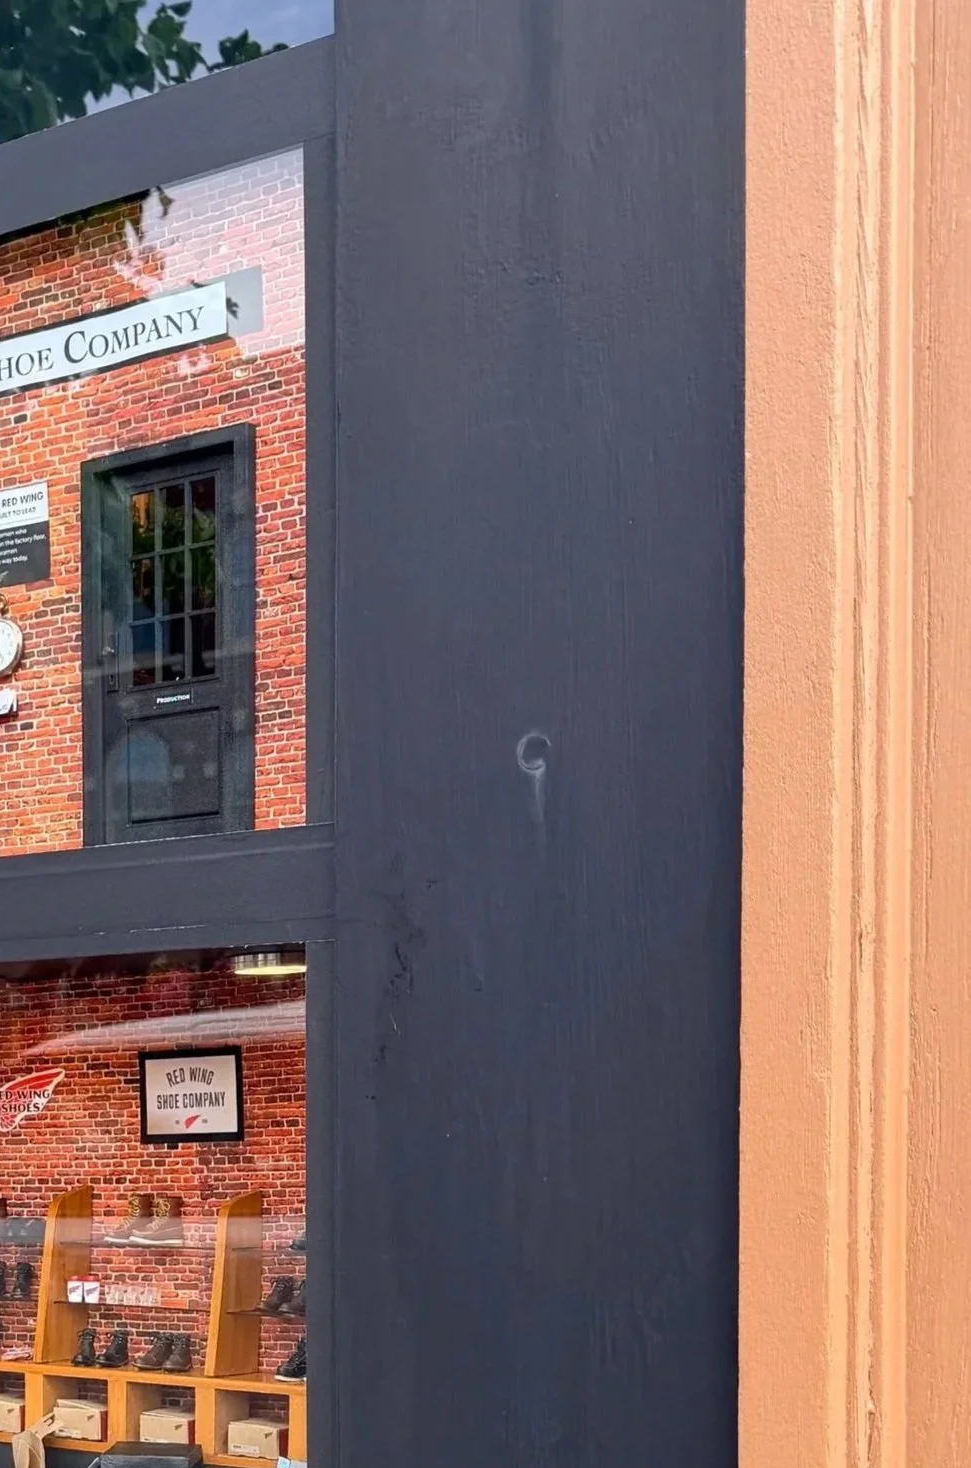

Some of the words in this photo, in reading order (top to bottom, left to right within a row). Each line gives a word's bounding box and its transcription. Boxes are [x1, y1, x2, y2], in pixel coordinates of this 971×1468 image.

[63, 306, 206, 364] COMPANY
[1, 497, 18, 508] RED
[20, 491, 44, 504] WING
[166, 1067, 186, 1087] RED
[189, 1066, 215, 1086] WING
[17, 1089, 50, 1099] WING
[156, 1093, 180, 1110] SHOE
[182, 1091, 225, 1108] COMPANY
